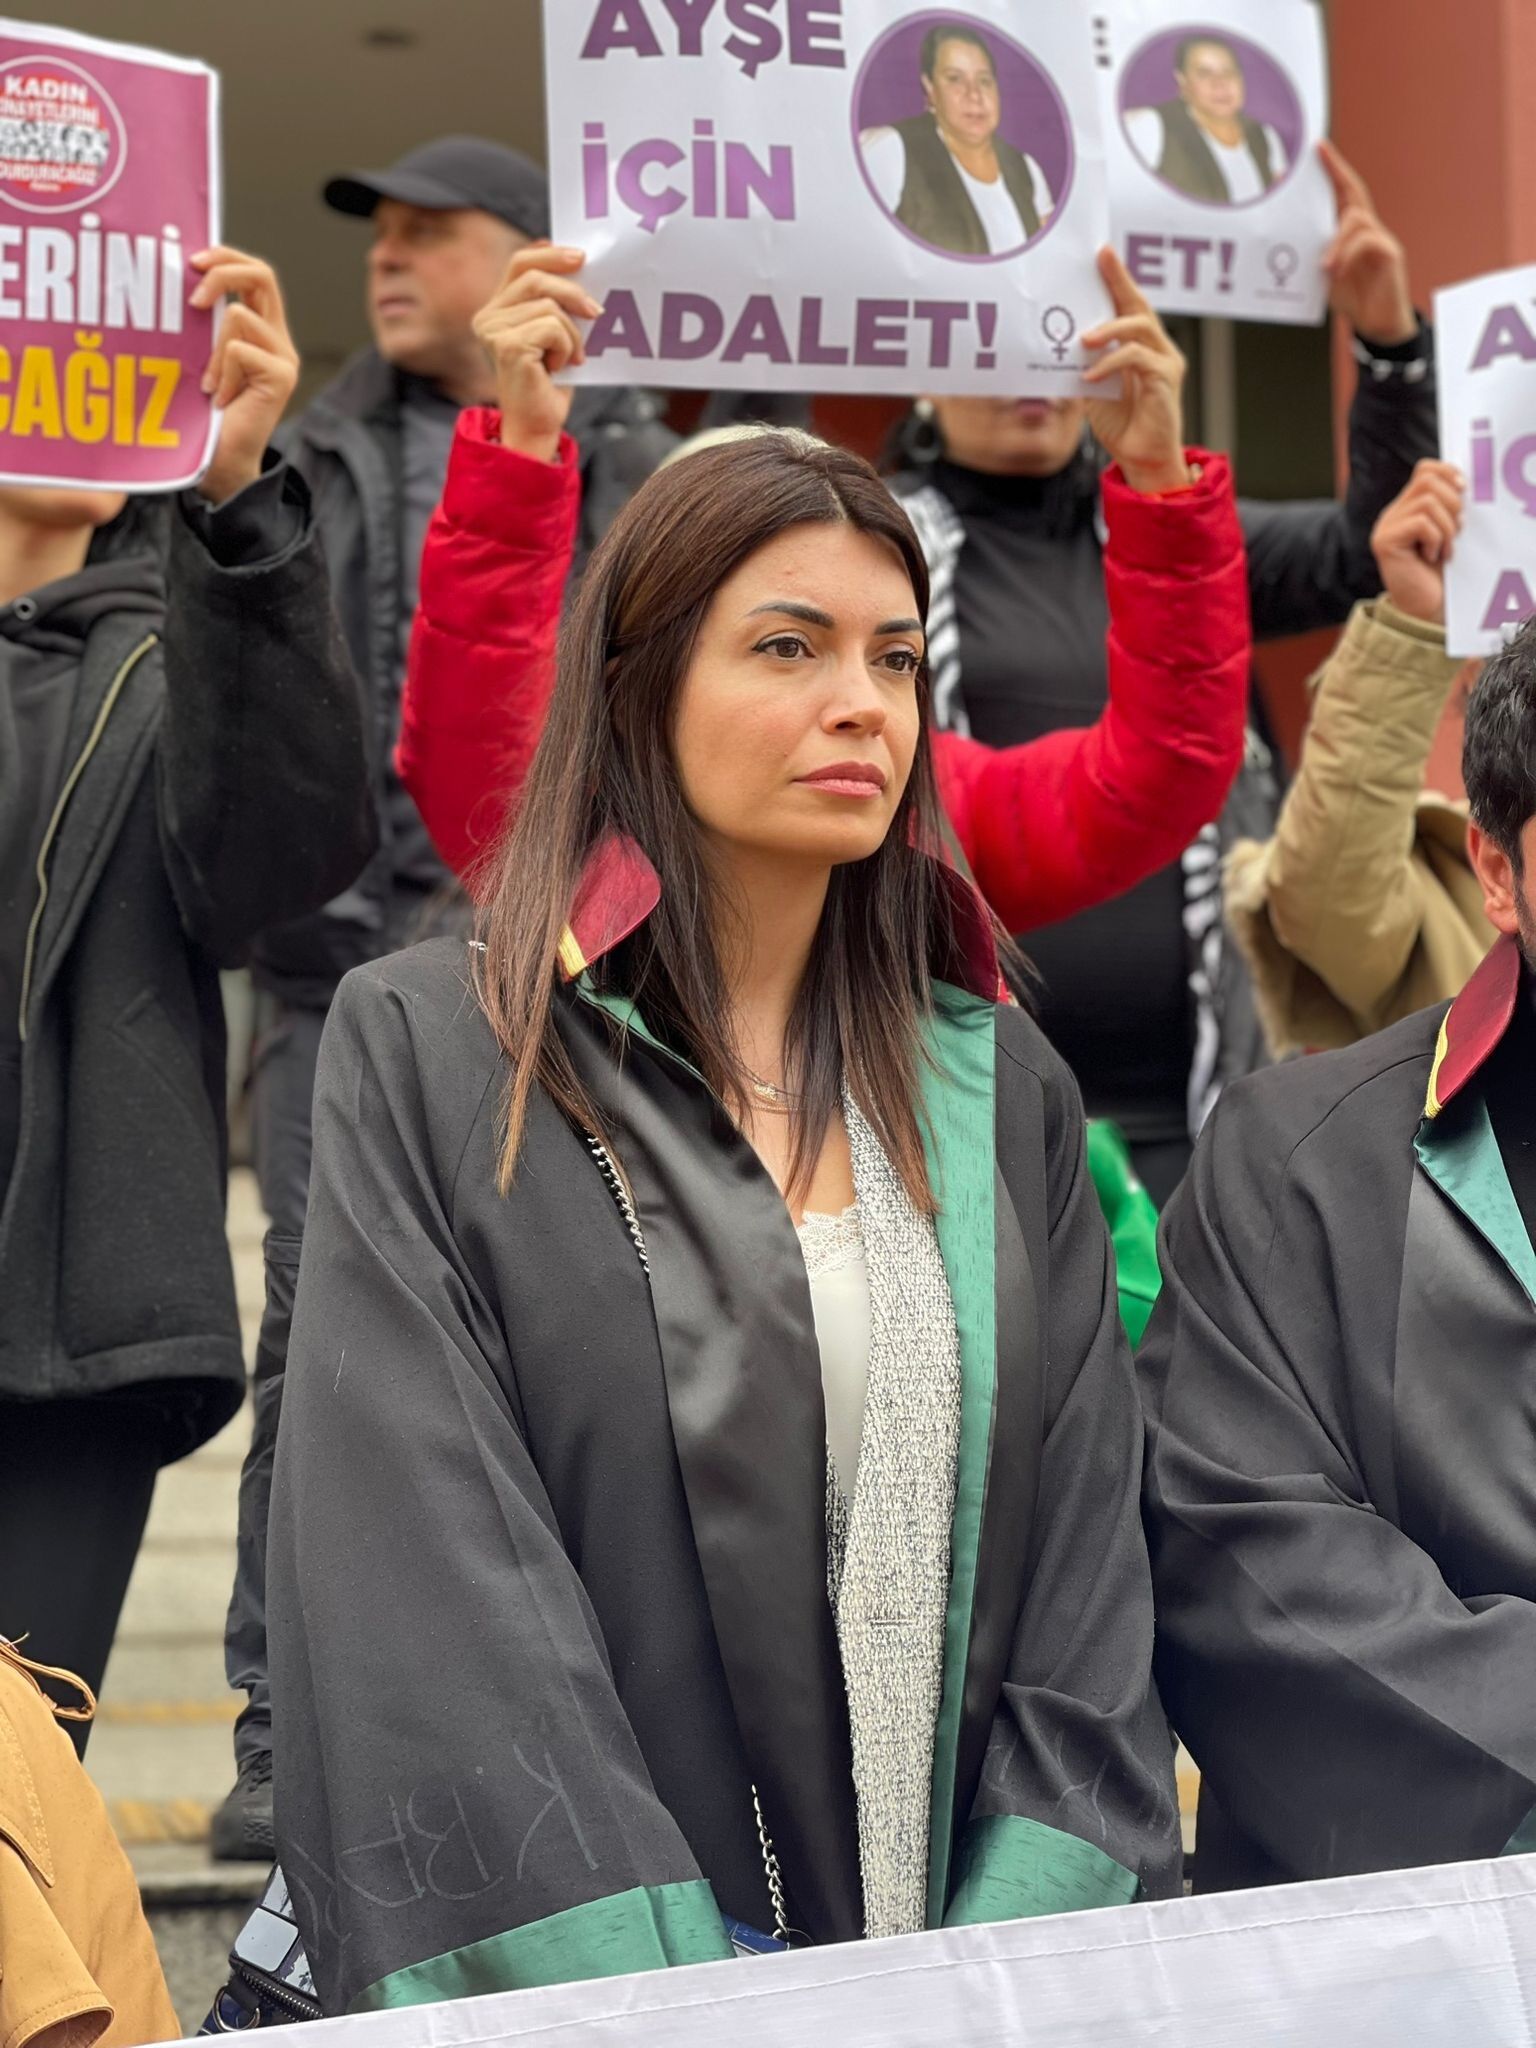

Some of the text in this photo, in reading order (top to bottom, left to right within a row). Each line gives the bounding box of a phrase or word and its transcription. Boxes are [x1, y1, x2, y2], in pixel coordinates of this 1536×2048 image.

[579, 0, 847, 80] AYŞE
[5, 75, 88, 104] KADIN
[582, 118, 796, 233] İÇİN
[584, 288, 998, 370] ADALET!
[1468, 298, 1536, 370] A
